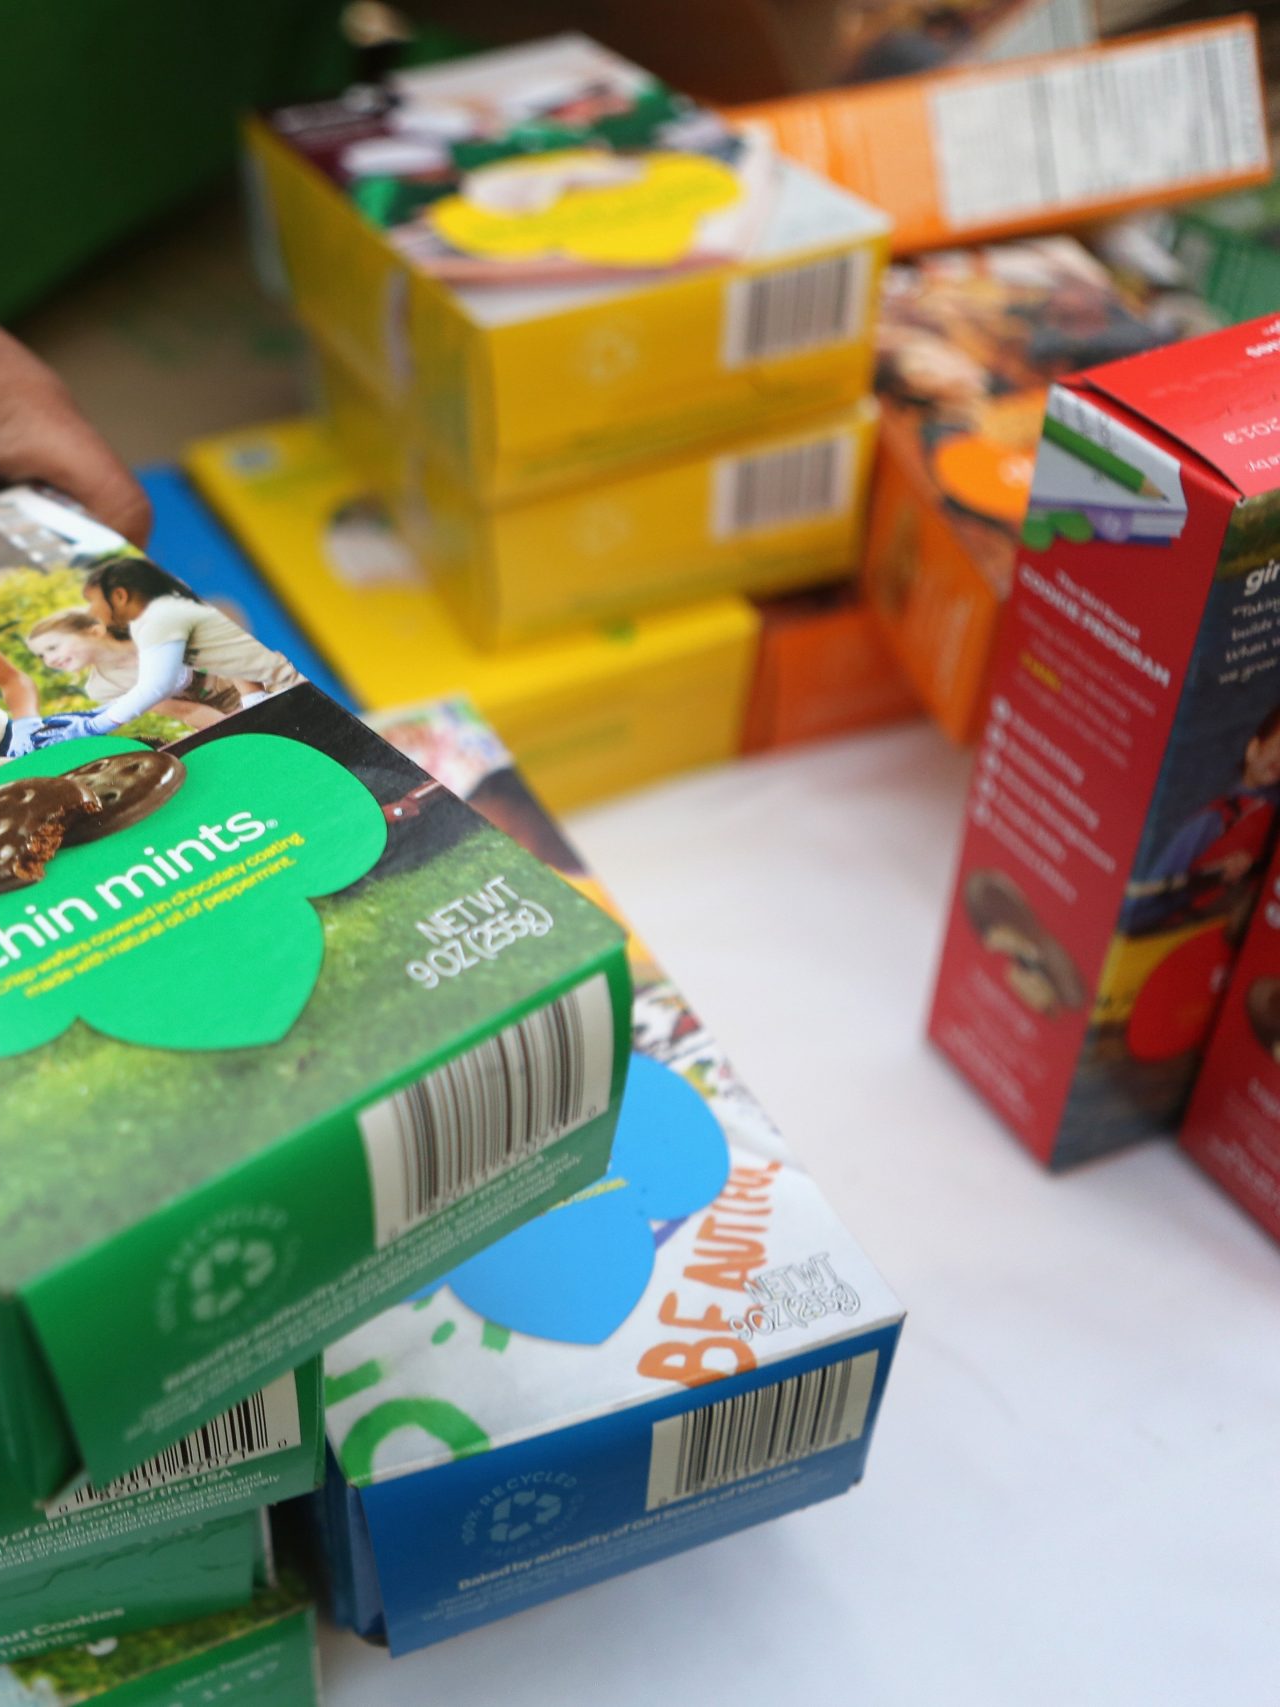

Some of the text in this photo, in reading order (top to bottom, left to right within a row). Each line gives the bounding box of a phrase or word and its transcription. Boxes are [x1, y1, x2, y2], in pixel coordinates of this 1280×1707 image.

[1244, 559, 1280, 597] gir
[36, 941, 91, 973] wafers
[90, 906, 156, 946] covered
[154, 901, 172, 914] in
[172, 861, 247, 906] chocolaty
[246, 832, 305, 867] coating
[415, 875, 520, 945] NET WT
[24, 968, 75, 998] made
[74, 950, 110, 974] with
[106, 921, 165, 959] natural
[164, 911, 185, 928] oil
[184, 900, 202, 918] of
[742, 1250, 838, 1304] NET WT
[10, 1527, 32, 1541] of
[33, 1516, 67, 1535] Girl
[70, 1497, 134, 1524] Scouts
[136, 1490, 156, 1504] of
[158, 1480, 190, 1497] the
[480, 1470, 577, 1507] RECYCLED
[456, 1564, 511, 1591] Baked
[509, 1556, 536, 1575] by
[533, 1529, 611, 1566] authority
[610, 1523, 633, 1538] of
[631, 1513, 662, 1530] Girl
[31, 1602, 125, 1639] Cookies
